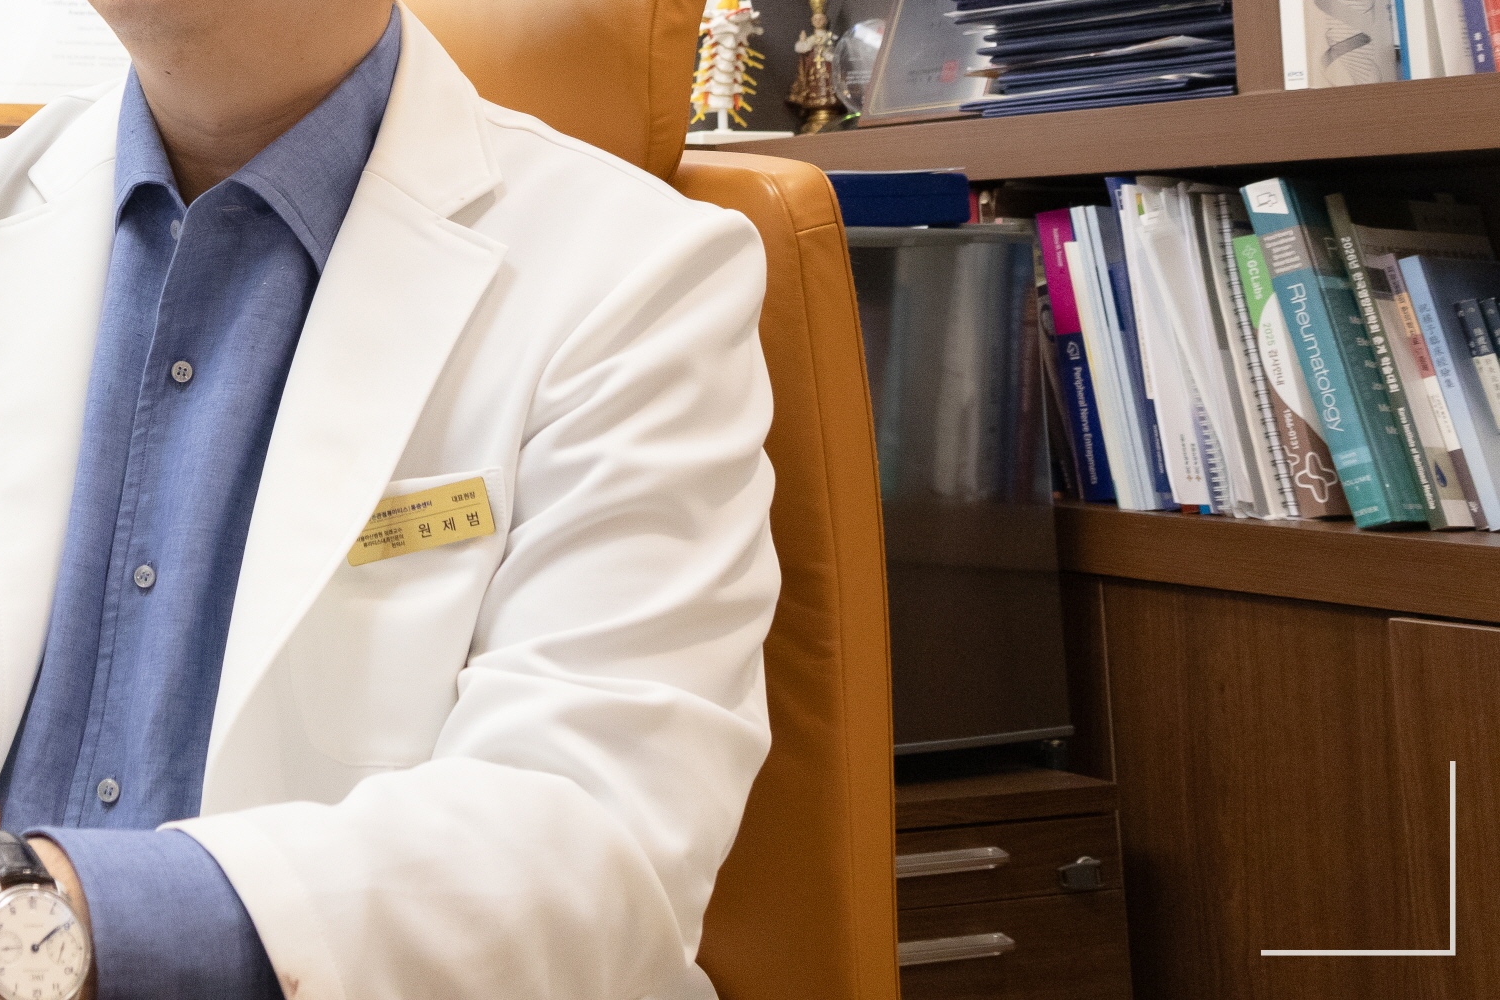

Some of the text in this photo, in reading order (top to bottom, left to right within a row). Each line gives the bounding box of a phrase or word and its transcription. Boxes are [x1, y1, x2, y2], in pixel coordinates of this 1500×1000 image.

[1263, 322, 1285, 386] 2025 검사안내
[1287, 283, 1344, 432] Rheumatology
[1341, 236, 1360, 269] 2026년
[1381, 356, 1400, 393] 학술대회
[1073, 366, 1098, 485] Peripheral Nerve Entrapments
[451, 491, 476, 503] 대표원장
